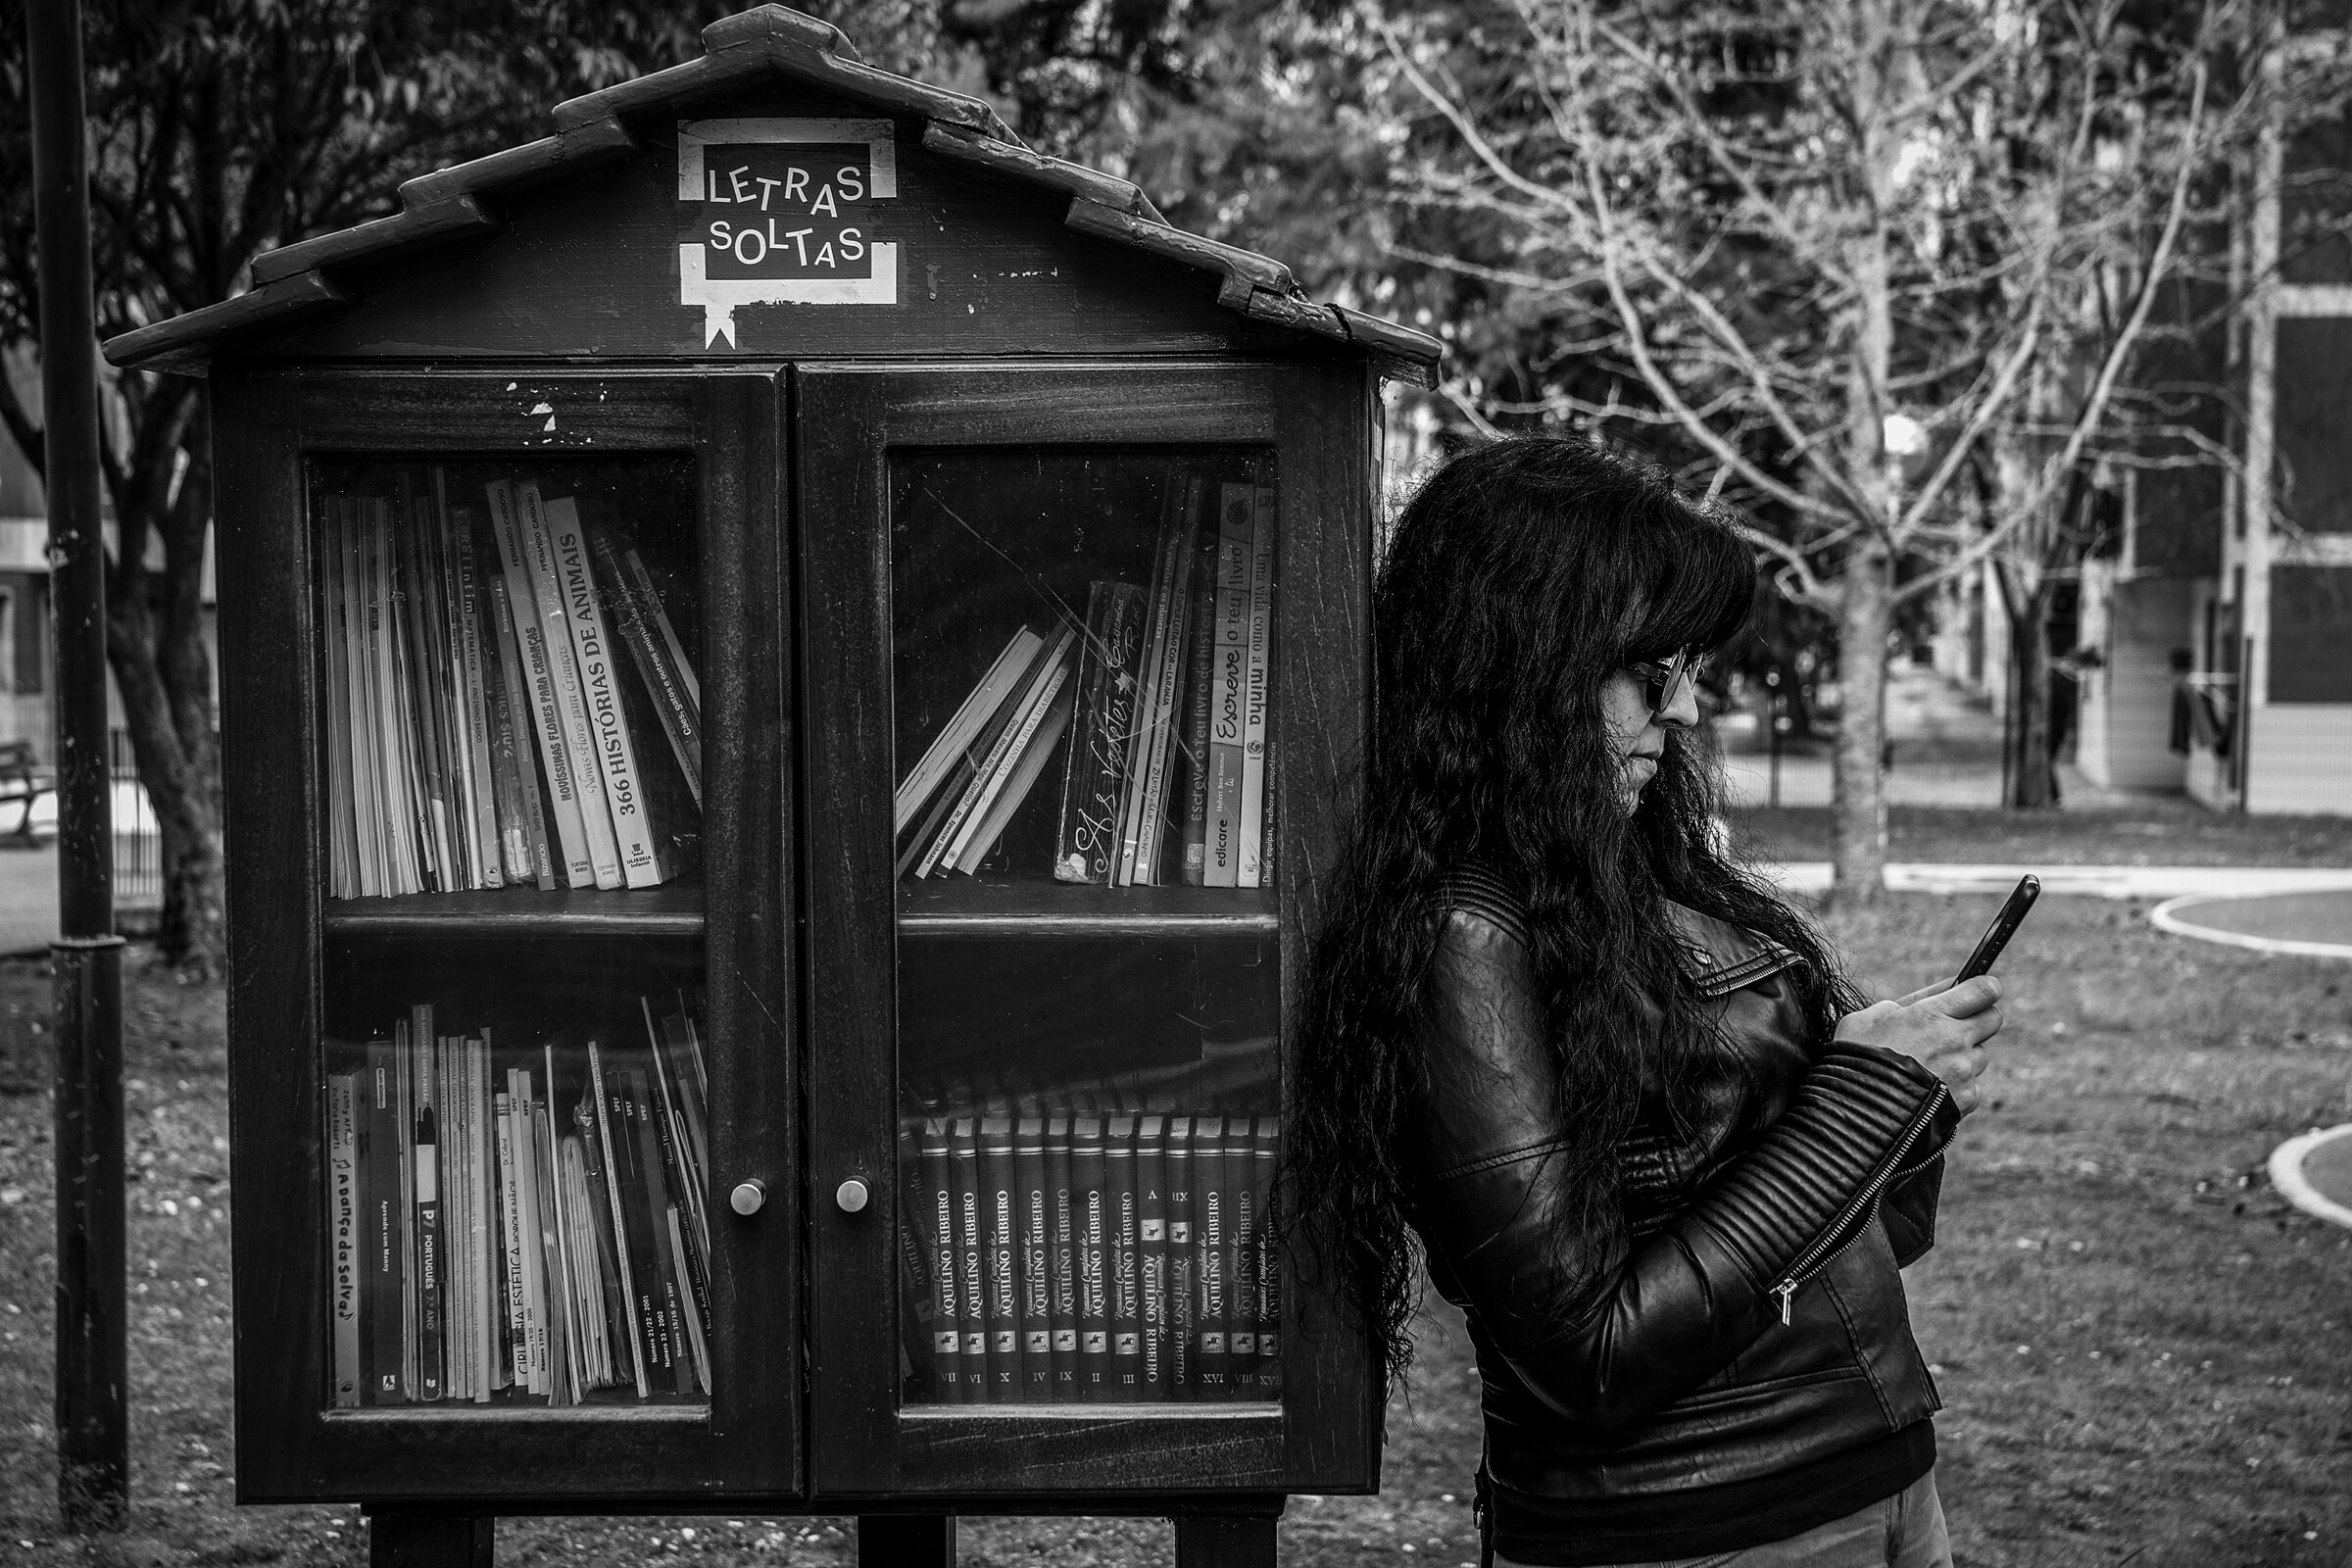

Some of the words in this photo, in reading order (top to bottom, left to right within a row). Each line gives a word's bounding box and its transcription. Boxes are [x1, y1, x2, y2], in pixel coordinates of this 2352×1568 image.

[710, 166, 863, 218] LETRAS
[710, 219, 864, 268] SOLTAS
[496, 488, 511, 524] CARDOSO
[525, 491, 540, 528] CARDOSO
[504, 525, 519, 566] FERNANDO
[533, 531, 549, 570] FERNANDO
[559, 532, 593, 623] ANIMAIS
[1163, 552, 1172, 582] estrelas
[1228, 547, 1245, 584] livro
[1255, 552, 1268, 580] Uma
[1160, 593, 1166, 602] os
[1173, 595, 1183, 618] SUPER
[1226, 596, 1242, 623] teu
[1253, 586, 1267, 612] vida
[1107, 597, 1125, 669] Cassandra
[1154, 604, 1166, 639] planetas
[1170, 619, 1181, 646] LEITÃO
[1226, 630, 1238, 640] o
[1251, 616, 1263, 651] como
[524, 625, 547, 674] CRIANÇAS
[579, 627, 600, 657] DE
[1167, 647, 1176, 663] COR
[466, 619, 476, 670] MATEMÁTICA
[474, 722, 483, 743] BÁSICO
[555, 644, 577, 693] Crianças
[649, 652, 667, 680] outros
[1195, 660, 1208, 677] de
[535, 676, 551, 703] PARA
[664, 685, 683, 711] gatos
[1161, 671, 1172, 706] LARANJA
[1195, 683, 1207, 715] livro
[1215, 649, 1240, 738] Escreve
[1248, 667, 1266, 725] minha
[566, 694, 584, 719] para
[583, 662, 626, 777] HISTÓRIAS
[541, 704, 560, 741] FLORES
[674, 710, 694, 736] Cães,
[997, 738, 1025, 777] COZINHA
[1021, 716, 1038, 738] PARA
[1033, 668, 1067, 716] DIABÉTICOS
[1004, 718, 1019, 738] Quem
[1194, 720, 1205, 746] teu
[566, 721, 590, 757] Flores
[991, 737, 1007, 758] Mexeu
[985, 758, 995, 768] No
[1195, 750, 1204, 759] o
[1266, 741, 1278, 789] competências
[547, 742, 572, 802] NOVÍSSIMAS
[575, 757, 598, 795] Novas
[976, 767, 988, 782] Meu
[612, 778, 636, 816] 366
[960, 780, 981, 807] Queijo?
[1265, 792, 1274, 822] melhorar
[953, 809, 961, 820] Dr.
[938, 818, 956, 843] Spencer
[1076, 792, 1115, 874] As
[1215, 819, 1227, 866] edicare
[1265, 827, 1274, 857] equipas,
[536, 843, 549, 876] Bizâncio
[626, 856, 652, 864] ULISSEIA
[924, 841, 943, 865] Johnson
[1262, 859, 1273, 882] Dirigir
[591, 1052, 600, 1084] NATIONAL
[596, 1085, 606, 1126] GEOGRAPHIC
[331, 1119, 340, 1149] Roberts
[338, 1174, 348, 1183] A
[508, 1180, 516, 1204] NÃO?
[1149, 1190, 1157, 1200] V
[1172, 1193, 1188, 1201] XII
[337, 1188, 351, 1236] Dança
[422, 1209, 434, 1227] P7
[937, 1191, 951, 1245] RIBEIRO
[963, 1193, 976, 1246] RIBEIRO
[997, 1191, 1010, 1245] RIBEIRO
[1031, 1191, 1044, 1245] RIBEIRO
[1088, 1191, 1101, 1245] RIBEIRO
[1122, 1192, 1134, 1246] RIBEIRO
[1207, 1192, 1220, 1246] RIBEIRO
[337, 1240, 352, 1260] da
[1081, 1230, 1088, 1246] de
[381, 1249, 390, 1272] Manny
[424, 1234, 434, 1289] PORTUGUÊS
[1079, 1246, 1092, 1283] Completos
[337, 1265, 353, 1309] Selva
[507, 1247, 523, 1305] ESTÉTICA
[941, 1250, 956, 1317] AQUILINO
[966, 1252, 982, 1319] AQUILINO
[999, 1250, 1014, 1317] AQUILINO
[1033, 1250, 1048, 1317] AQUILINO
[1090, 1250, 1105, 1317] AQUILINO
[1123, 1251, 1138, 1318] AQUILINO
[1209, 1251, 1224, 1319] AQUILINO
[1082, 1283, 1093, 1319] Romances
[645, 1316, 655, 1337] 21/22
[656, 1310, 664, 1327] 2002
[514, 1311, 527, 1374] CIRURGIA
[649, 1338, 658, 1362] Número
[660, 1332, 666, 1342] 23
[673, 1332, 683, 1357] Número
[661, 1343, 670, 1367] Número
[941, 1373, 956, 1382] VII
[969, 1375, 981, 1384] VI
[1001, 1373, 1009, 1382] X
[1059, 1372, 1072, 1381] IX
[1092, 1373, 1100, 1382] II
[1123, 1374, 1134, 1383] III
[1203, 1374, 1224, 1383] XVI
[1235, 1374, 1252, 1383] VIII
